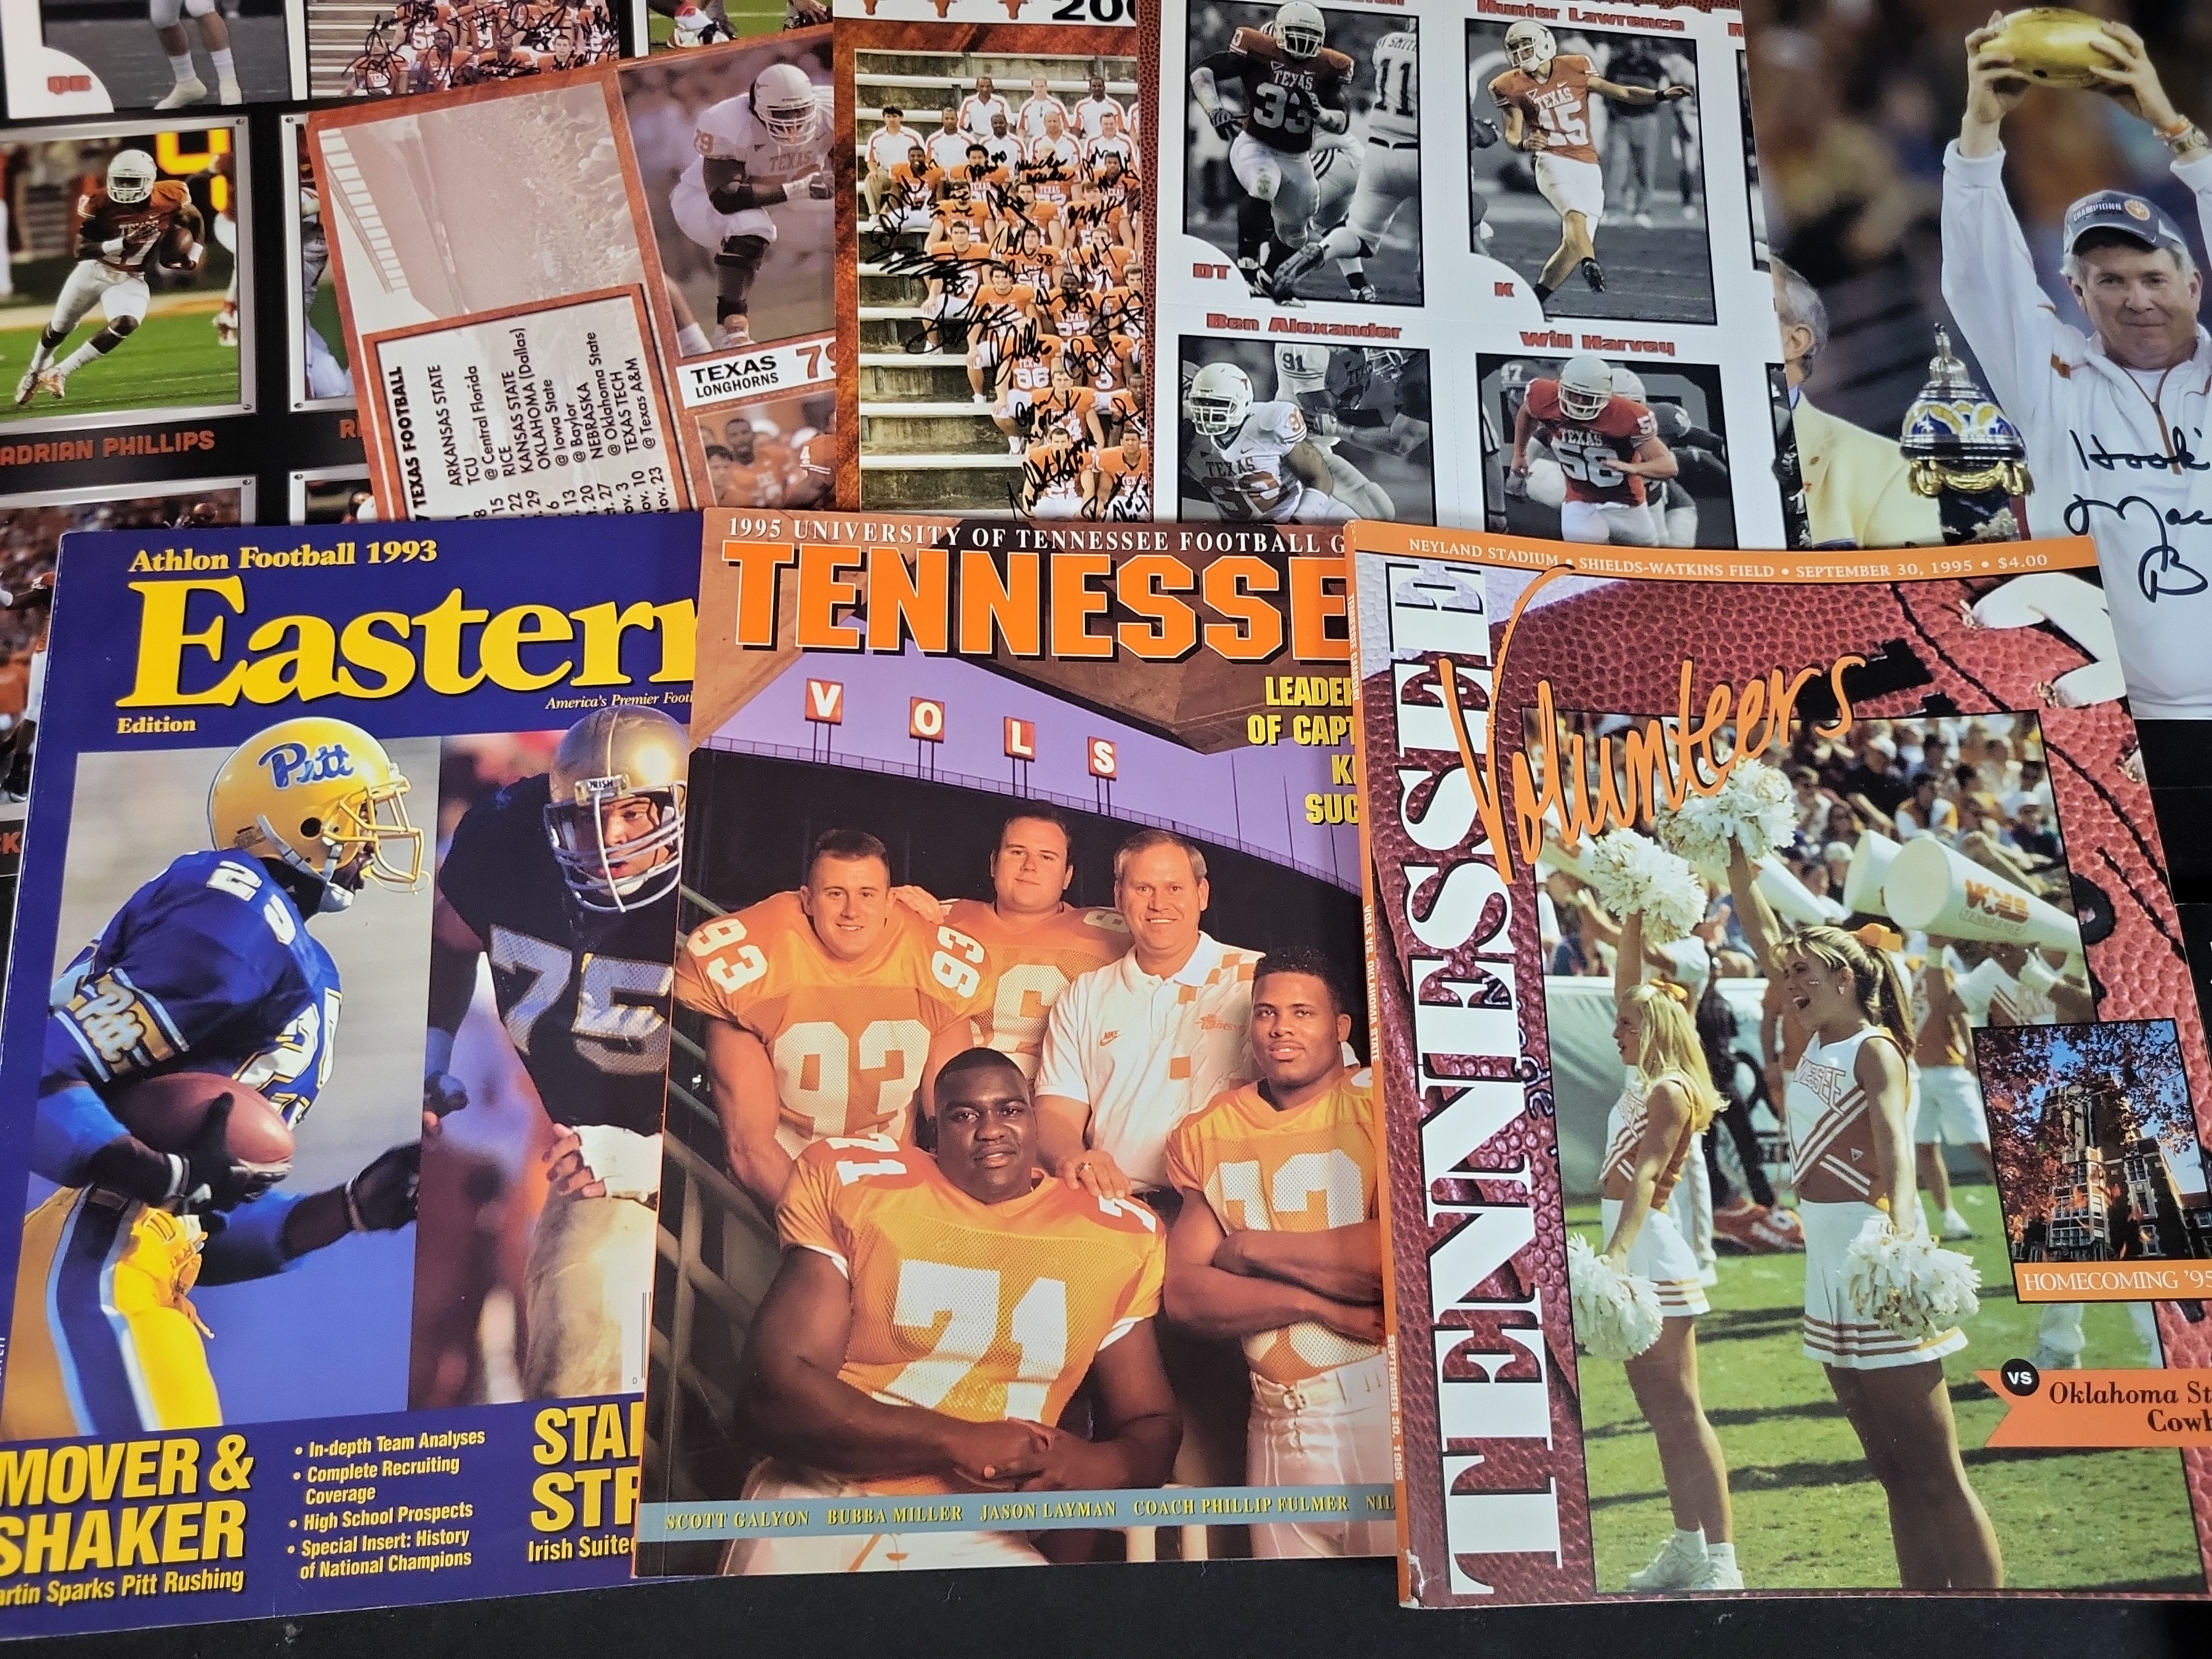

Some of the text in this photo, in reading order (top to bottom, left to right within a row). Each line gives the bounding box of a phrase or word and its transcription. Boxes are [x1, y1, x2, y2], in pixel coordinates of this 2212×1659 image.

[1568, 7, 1685, 32] Lawrence
[1273, 70, 1314, 90] TEXAS
[1535, 86, 1575, 110] TEXAS
[1193, 263, 1231, 280] DT
[1494, 282, 1515, 298] K
[1206, 312, 1402, 340] Ben Alexander
[1519, 330, 1676, 356] Will Harvey
[509, 328, 536, 380] (Dallas)
[586, 331, 602, 367] State
[1282, 352, 1307, 373] 91
[690, 356, 778, 384] TEXAS
[695, 372, 780, 399] LONGHORNS
[389, 365, 416, 442] FOOTBALL
[464, 365, 486, 414] Florida
[501, 370, 521, 410] STATE
[542, 378, 558, 414] State
[594, 369, 618, 441] Oklahoma
[427, 364, 463, 487] ARKANSAS STATE
[521, 381, 551, 470] OKLAHOMA
[551, 416, 566, 452] Iowa
[563, 402, 584, 447] Baylor
[576, 382, 604, 460] NEBRASKA
[609, 371, 646, 488] 10 TEXAS TECH
[624, 357, 665, 485] 23 @ Texas A&M
[1558, 427, 1604, 447] TEXAS
[0, 430, 216, 467] ADRIAN PHILLIPS
[472, 415, 495, 465] Central
[510, 413, 535, 474] KANSAS
[572, 451, 586, 463] @
[608, 444, 621, 456] @
[406, 445, 427, 508] TEXAS
[463, 457, 481, 487] TCU
[484, 468, 498, 481] @
[498, 445, 517, 477] RICE
[555, 455, 568, 467] @
[1204, 458, 1256, 477] TEXAS
[728, 516, 1320, 554] 1995 UNIVERSITY OF TENNESSEE FOOTBALL
[128, 539, 437, 573] Athlon Football 1993
[1408, 538, 2048, 578] NEYLAND STADIUM SHIELDS-WATKINS FIELD SEPTEMBER 30, 1995 $4.00
[1347, 593, 1360, 701] TENNESSEE GAMEDAY
[545, 692, 660, 710] America's Premier
[117, 716, 196, 735] Edition
[1246, 714, 1282, 745] OF
[1439, 564, 1866, 885] Volunteers
[258, 742, 355, 789] Pitt
[687, 918, 769, 993] 93
[931, 924, 986, 999] 93
[489, 924, 675, 1074] 75
[1363, 904, 1381, 1062] VOLS VS. OKLAHOMA STATE
[1103, 1030, 1120, 1040] NIKE
[774, 1020, 931, 1161] 93
[1385, 562, 1563, 1595] TENNESSEE
[2023, 1270, 2178, 1291] HOMECOMING
[877, 1259, 1068, 1426] 71
[1387, 1333, 1404, 1481] SEPTEMBER 30, 1995
[2049, 1381, 2178, 1405] Oklahoma
[309, 1430, 486, 1459] In-depth Team Analyses
[0, 1434, 254, 1507] MOVER &
[307, 1457, 460, 1485] Complete Recruiting
[305, 1486, 376, 1506] Coverage
[666, 1511, 728, 1531] SCOTT
[734, 1509, 810, 1528] GALYON
[827, 1506, 886, 1525] BUBBA
[893, 1504, 963, 1523] MILLER
[979, 1501, 1036, 1521] JASON
[1042, 1501, 1117, 1519] LAYMAN
[1132, 1498, 1194, 1516] COACH
[1199, 1496, 1273, 1514] PHILLIP
[1277, 1494, 1349, 1512] FULMER
[304, 1501, 473, 1533] High School Prospects
[301, 1528, 469, 1559] Special Insert: History
[528, 1539, 573, 1563] Irish
[300, 1550, 472, 1580] of National Champions
[46, 1568, 244, 1607] Sparks Pitt Rushing
